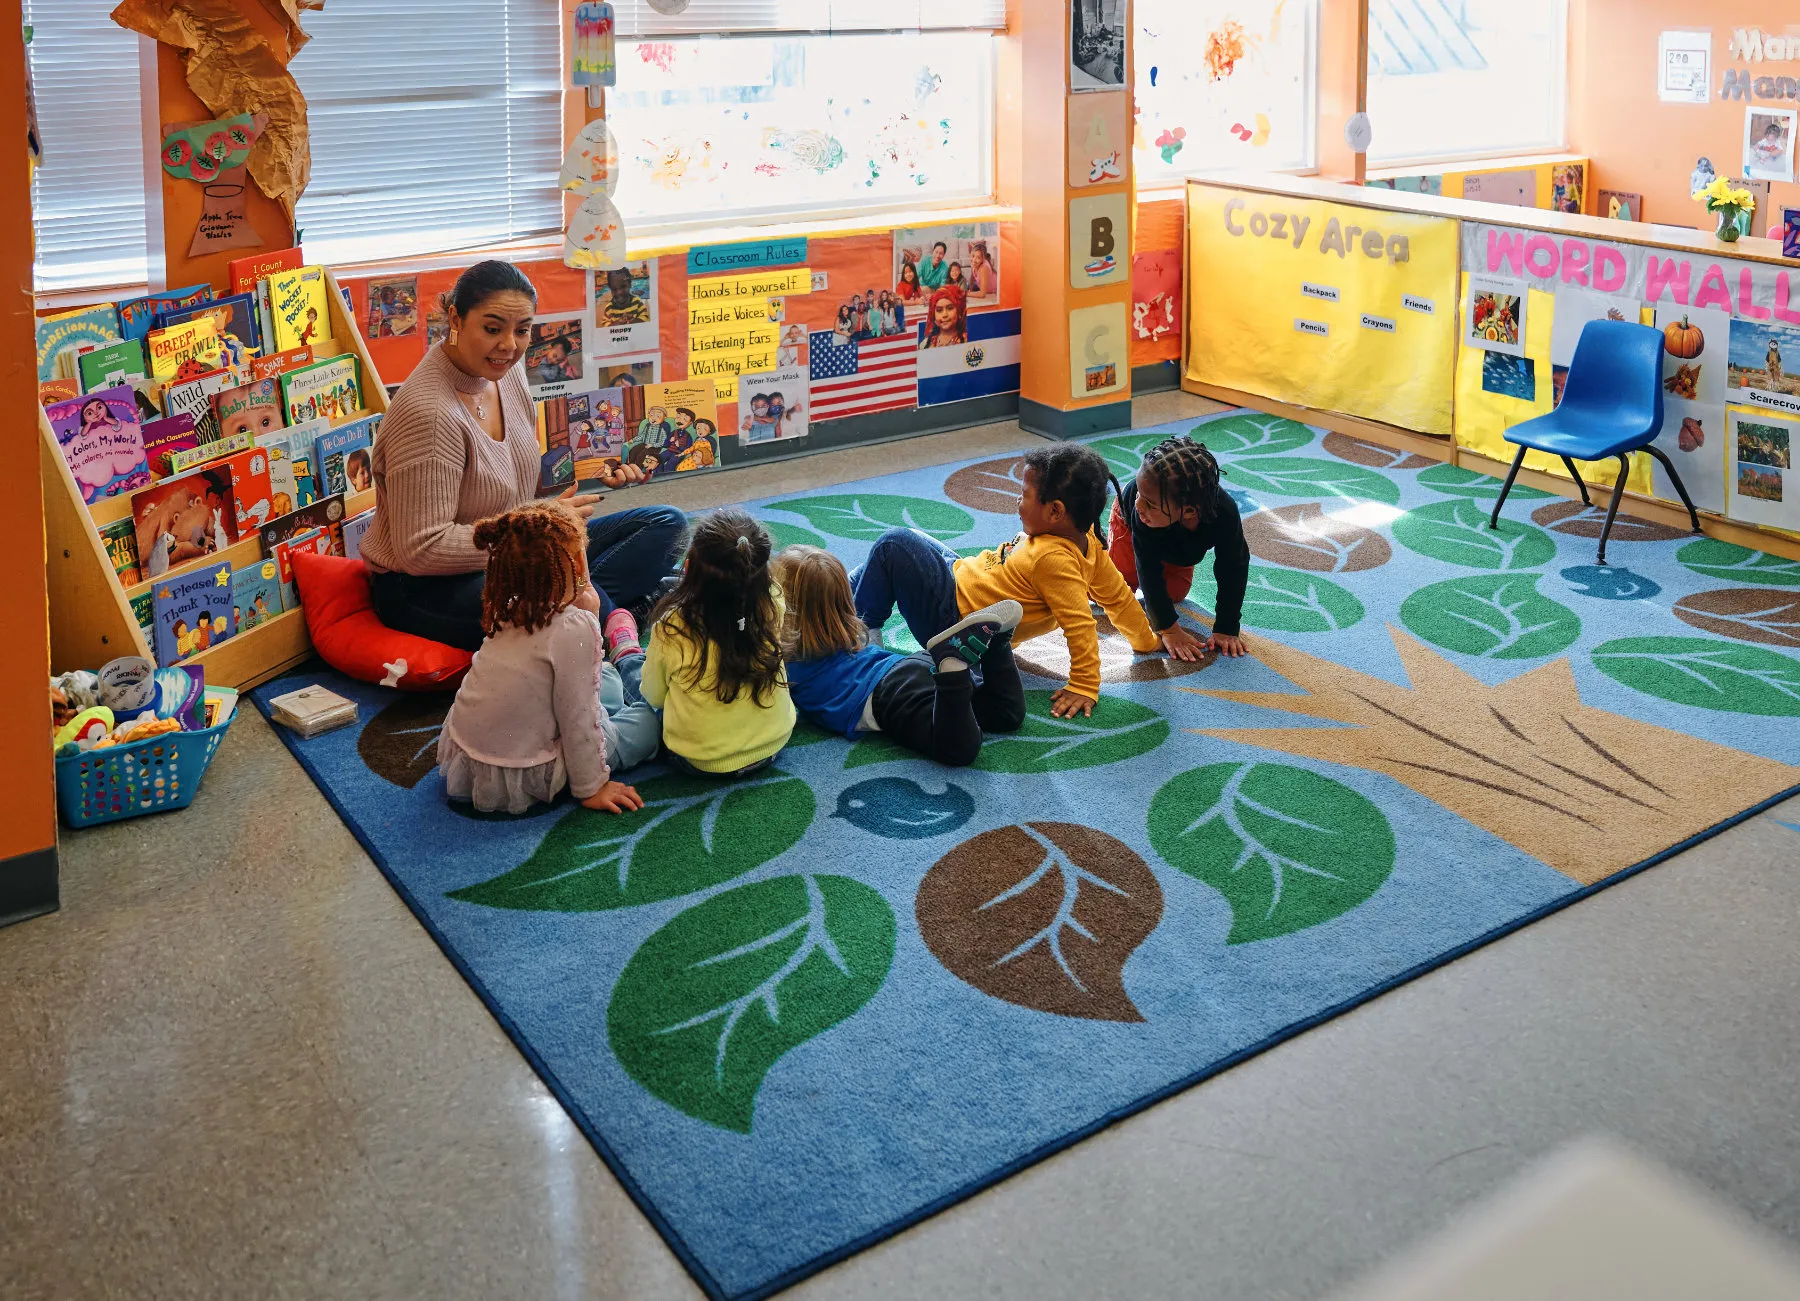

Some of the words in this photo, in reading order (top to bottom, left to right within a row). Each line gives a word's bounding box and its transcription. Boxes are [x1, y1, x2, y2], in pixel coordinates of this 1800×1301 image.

[1084, 113, 1112, 153] A
[1090, 216, 1115, 258] B
[1224, 198, 1310, 249] Cozy
[1319, 216, 1410, 264] Area
[260, 260, 282, 272] Count
[694, 251, 760, 267] Classroom
[766, 245, 800, 261] Rules
[239, 277, 253, 287] For
[693, 282, 730, 299] Hands
[735, 281, 748, 295] to
[751, 275, 798, 296] yourself
[1486, 228, 1626, 293] WORD
[1646, 254, 1800, 325] WALL
[278, 285, 302, 312] WOCKET
[1302, 285, 1337, 299] Backpack
[286, 292, 309, 325] POCKET!
[690, 308, 730, 325] Inside
[733, 305, 765, 320] Voices
[1404, 298, 1432, 312] Friends
[610, 327, 632, 335] Happy
[1300, 322, 1326, 334] Pencils
[1362, 317, 1393, 331] Crayons
[155, 328, 197, 358] CREEP!
[612, 335, 629, 343] Feliz
[692, 335, 746, 352] Listening
[749, 331, 771, 345] Ears
[1084, 324, 1110, 365] C
[175, 336, 216, 366] CRAWL!
[746, 353, 769, 369] Feet
[263, 356, 286, 376] SHAPE
[291, 376, 312, 390] Three
[313, 373, 330, 382] Little
[330, 364, 353, 378] Kittens
[540, 383, 565, 392] Sleepy
[746, 378, 764, 386] Wear
[766, 376, 783, 384] Your
[782, 372, 800, 381] Mask
[172, 382, 205, 409] Wild
[715, 384, 733, 399] ind
[220, 398, 248, 420] Baby
[248, 392, 276, 406] Faces
[73, 440, 98, 458] Colors,
[99, 436, 112, 446] My
[114, 434, 136, 445] World
[166, 430, 195, 442] Classroom
[322, 438, 334, 452] We
[332, 434, 347, 448] Can
[347, 430, 357, 442] Do
[70, 463, 81, 474] Mis
[82, 451, 104, 466] colores,
[114, 448, 134, 456] mundo
[270, 476, 287, 484] chool
[172, 577, 216, 600] Please!
[162, 597, 199, 624] Thank
[204, 593, 232, 606] You!
